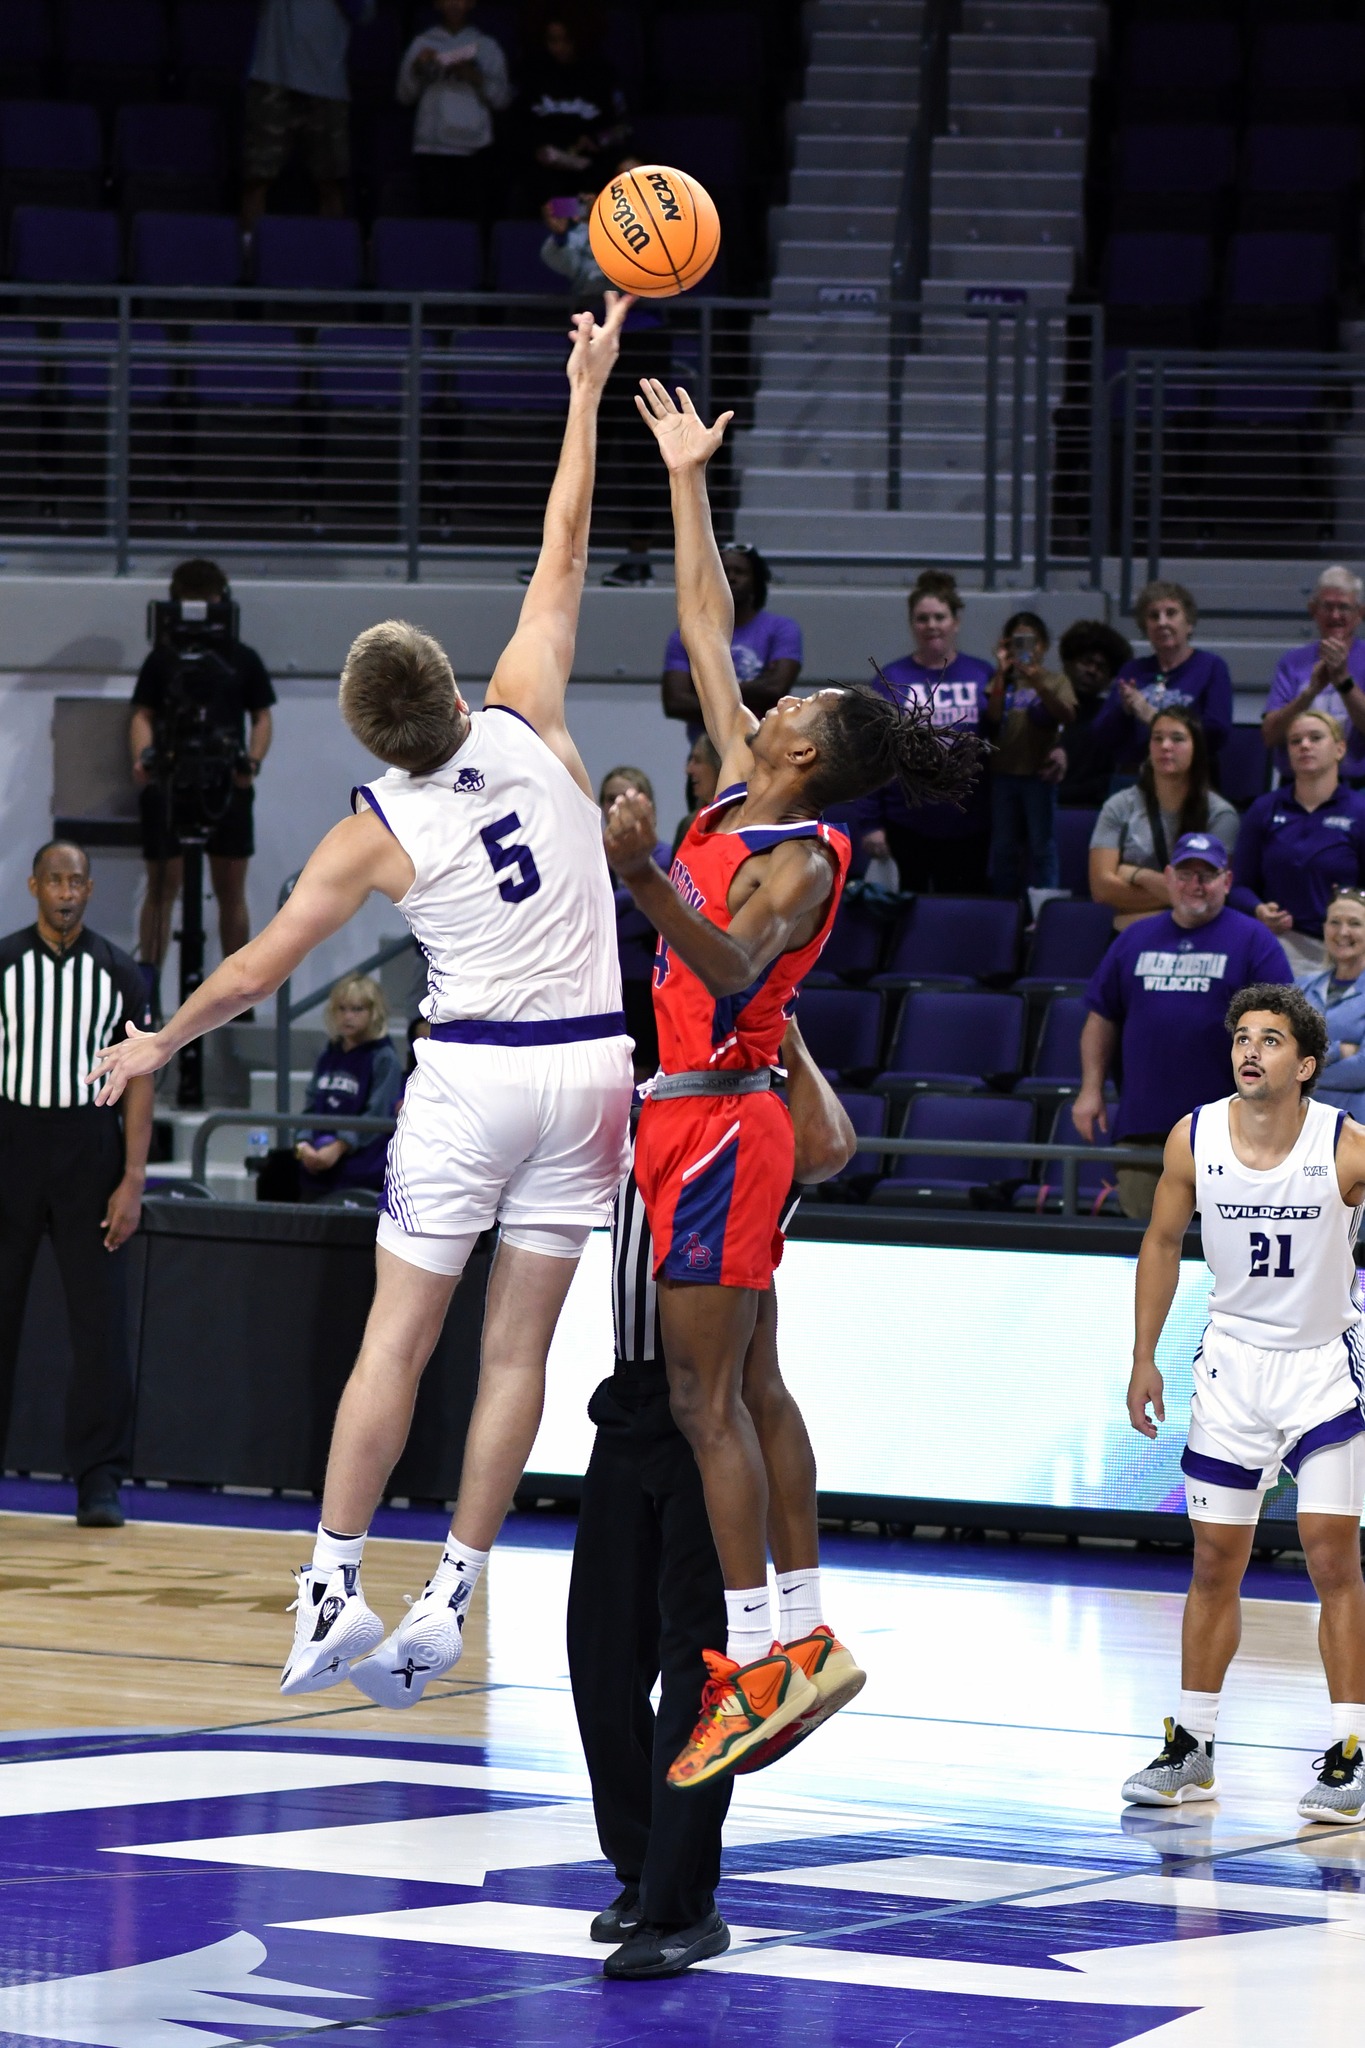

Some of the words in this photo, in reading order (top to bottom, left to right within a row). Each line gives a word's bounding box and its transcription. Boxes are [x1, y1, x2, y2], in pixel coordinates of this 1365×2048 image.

[646, 173, 682, 221] NCAA
[610, 179, 651, 255] Wilson
[904, 682, 978, 708] ACU
[453, 776, 485, 793] ACU
[479, 810, 541, 904] 5
[1143, 976, 1211, 992] WILDCATS
[1303, 1166, 1328, 1176] WAC
[1215, 1203, 1322, 1220] WILDCATS
[1248, 1232, 1295, 1278] 21
